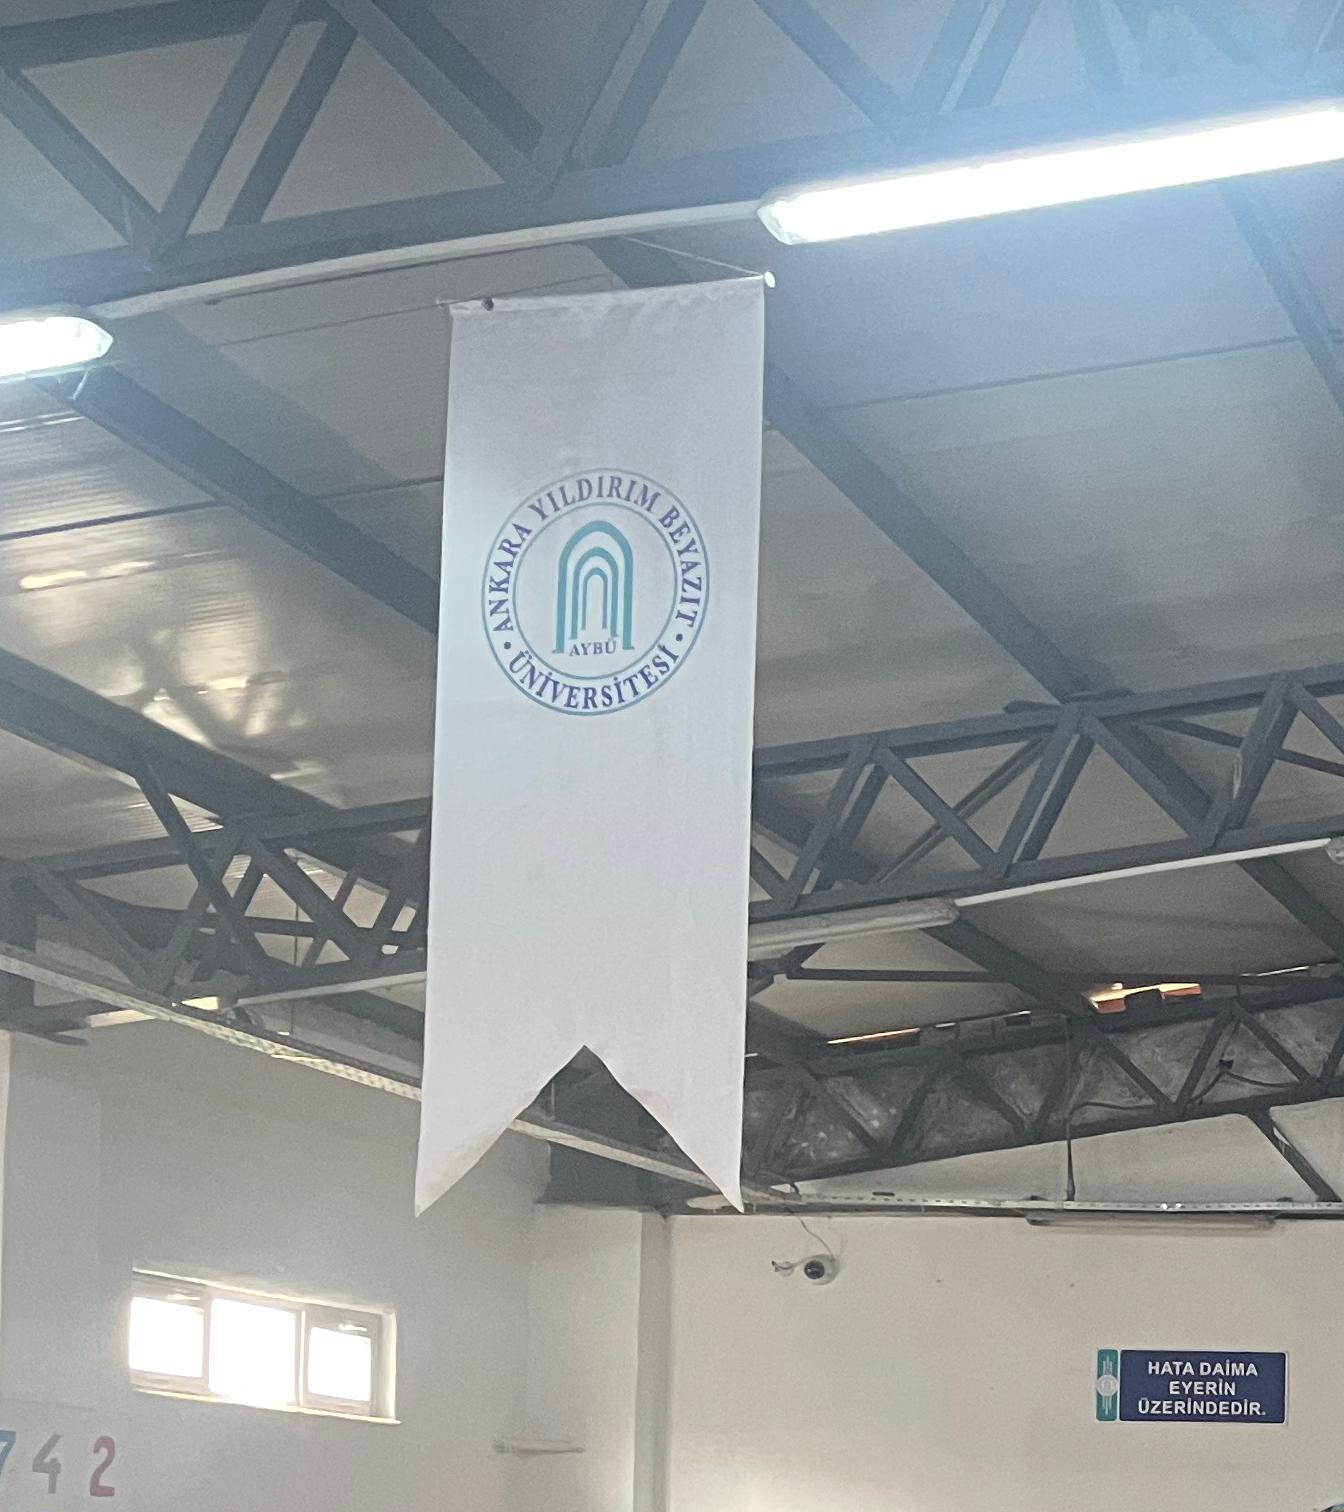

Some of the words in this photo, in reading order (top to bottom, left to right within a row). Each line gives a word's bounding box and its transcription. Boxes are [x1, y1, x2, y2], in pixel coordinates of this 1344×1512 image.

[488, 522, 533, 632] ANKARA
[528, 475, 663, 521] YILDIRIM
[658, 505, 702, 628] BEYAZIT
[568, 637, 617, 657] AYBÜ
[508, 643, 680, 710] ÜNİVERSİTESİ
[1147, 1361, 1195, 1376] HATA
[1200, 1359, 1258, 1377] DAİMA
[1169, 1378, 1236, 1396] EYERİN
[1138, 1397, 1266, 1416] ÜZERİNDEDİR.
[32, 1434, 62, 1494] 4
[90, 1435, 116, 1497] 2
